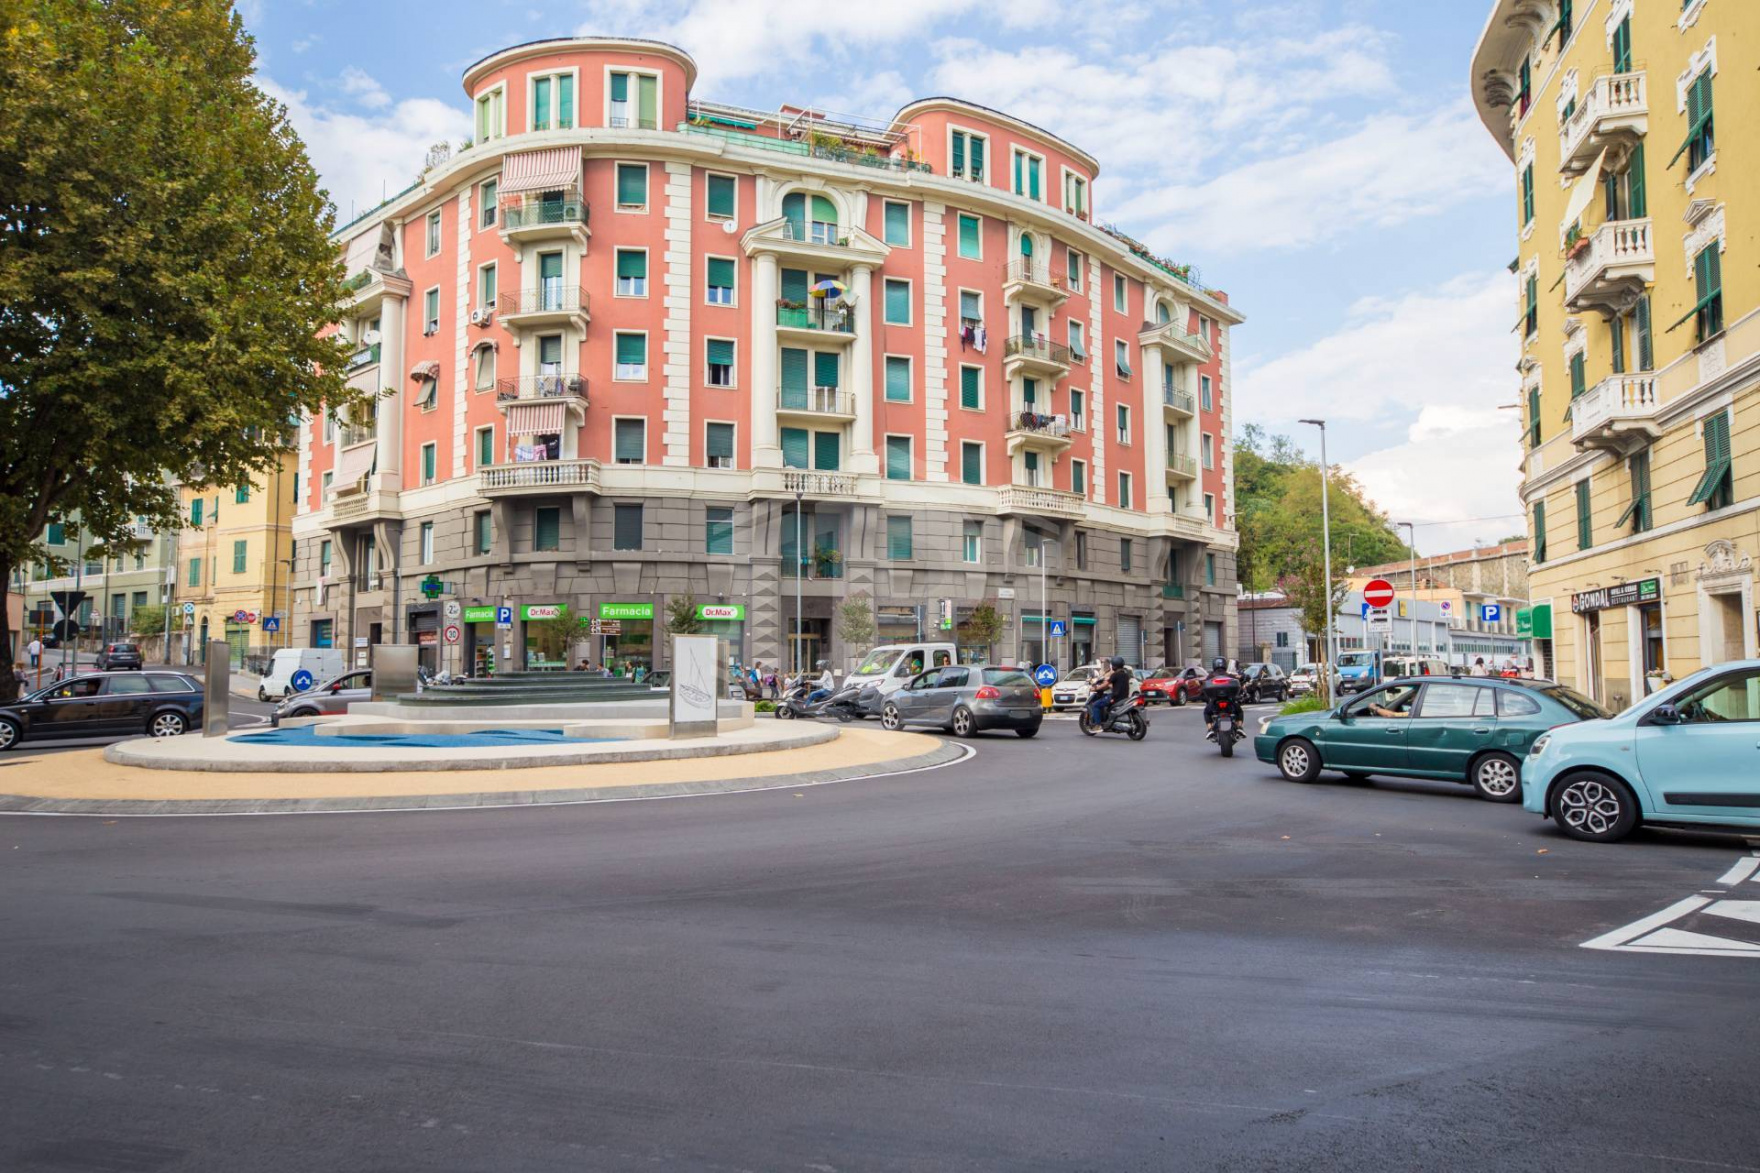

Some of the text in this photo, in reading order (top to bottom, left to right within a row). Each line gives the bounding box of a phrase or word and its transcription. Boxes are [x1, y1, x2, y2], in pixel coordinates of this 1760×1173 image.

[1579, 588, 1610, 611] GONDAL
[465, 610, 495, 619] Farmacia
[500, 609, 509, 621] P
[602, 607, 651, 616] Farmacia
[1485, 607, 1497, 620] P
